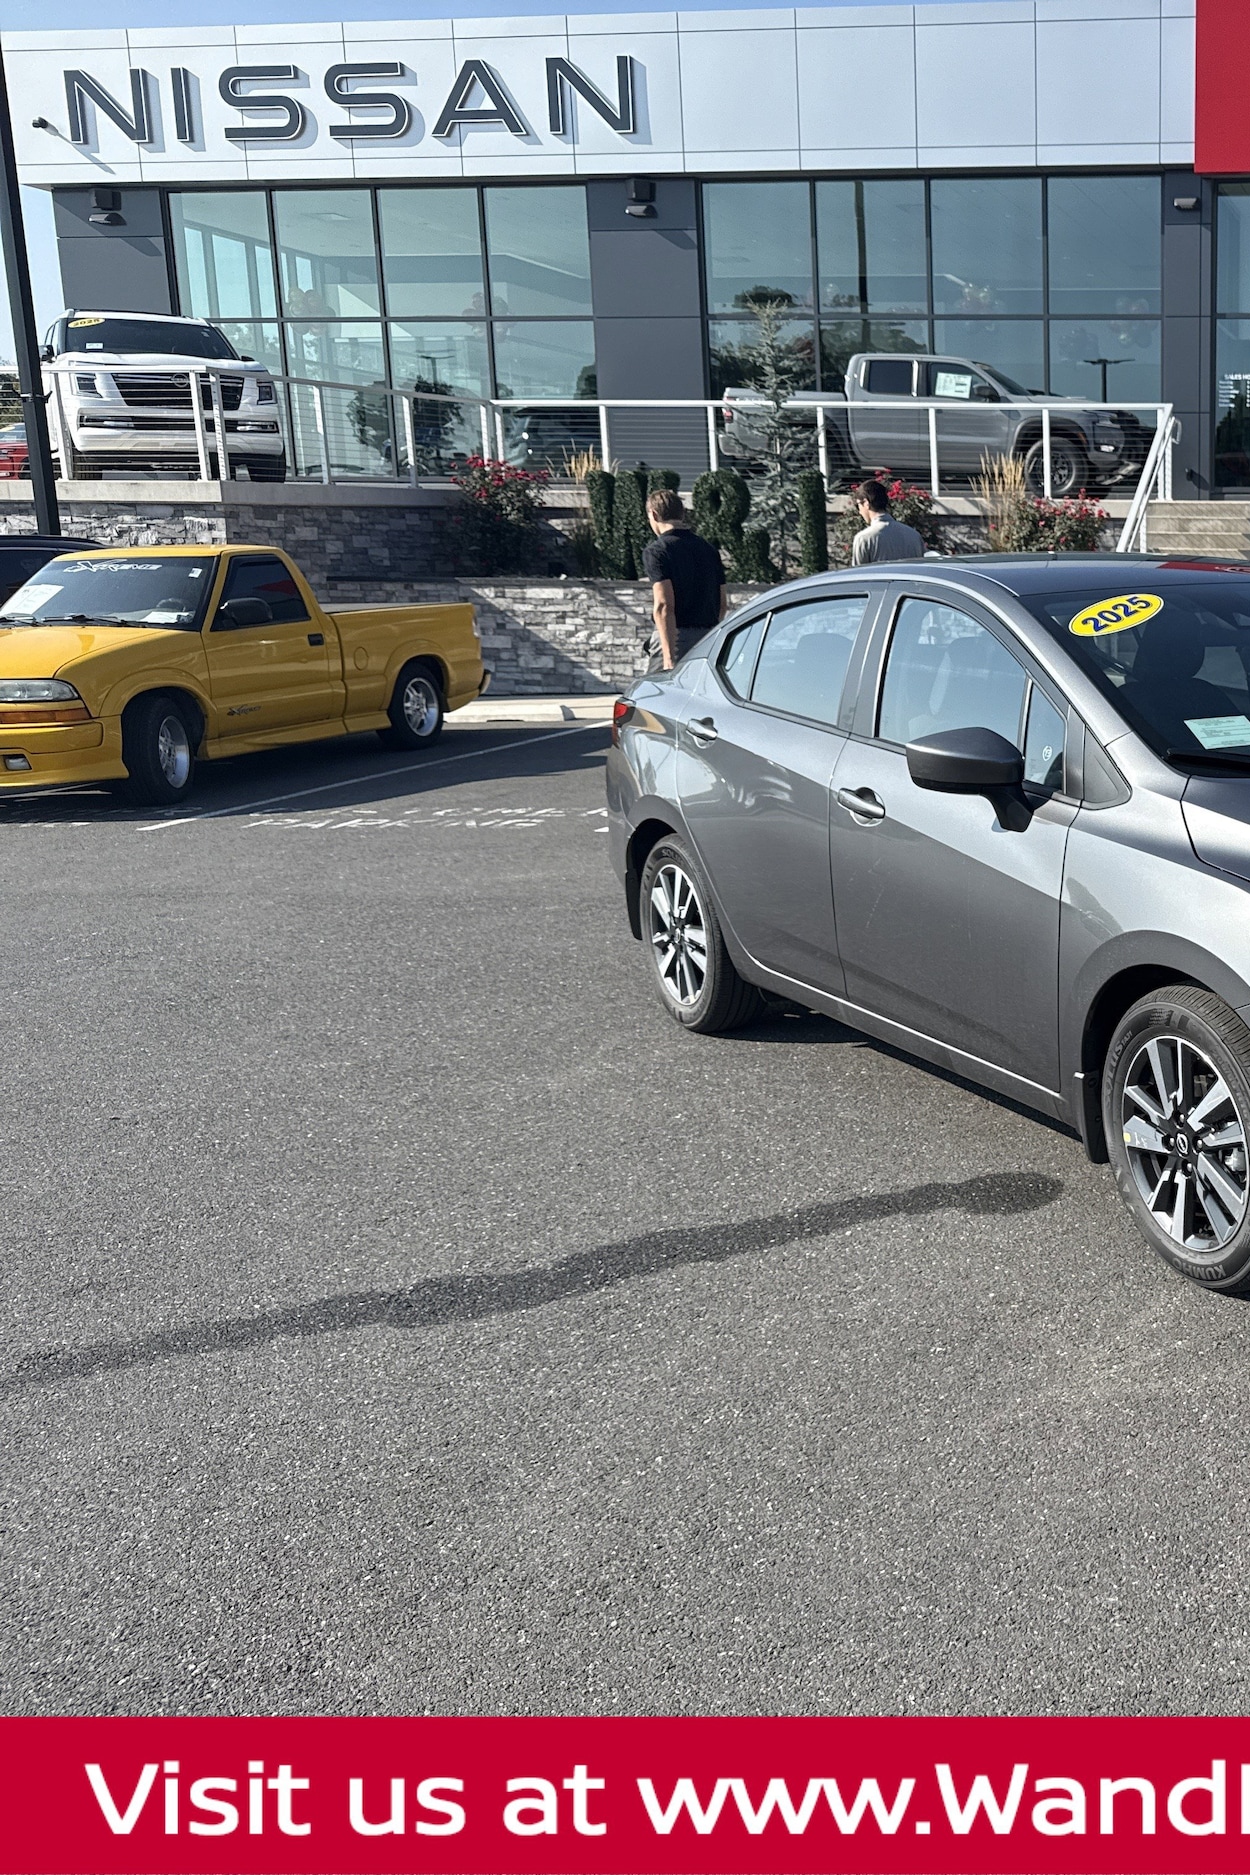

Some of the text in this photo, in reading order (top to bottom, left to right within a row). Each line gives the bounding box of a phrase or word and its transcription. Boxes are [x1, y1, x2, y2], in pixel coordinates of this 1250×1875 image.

[63, 55, 637, 144] NISSAN
[1081, 596, 1151, 632] 2025
[1172, 1257, 1227, 1280] KUMHO
